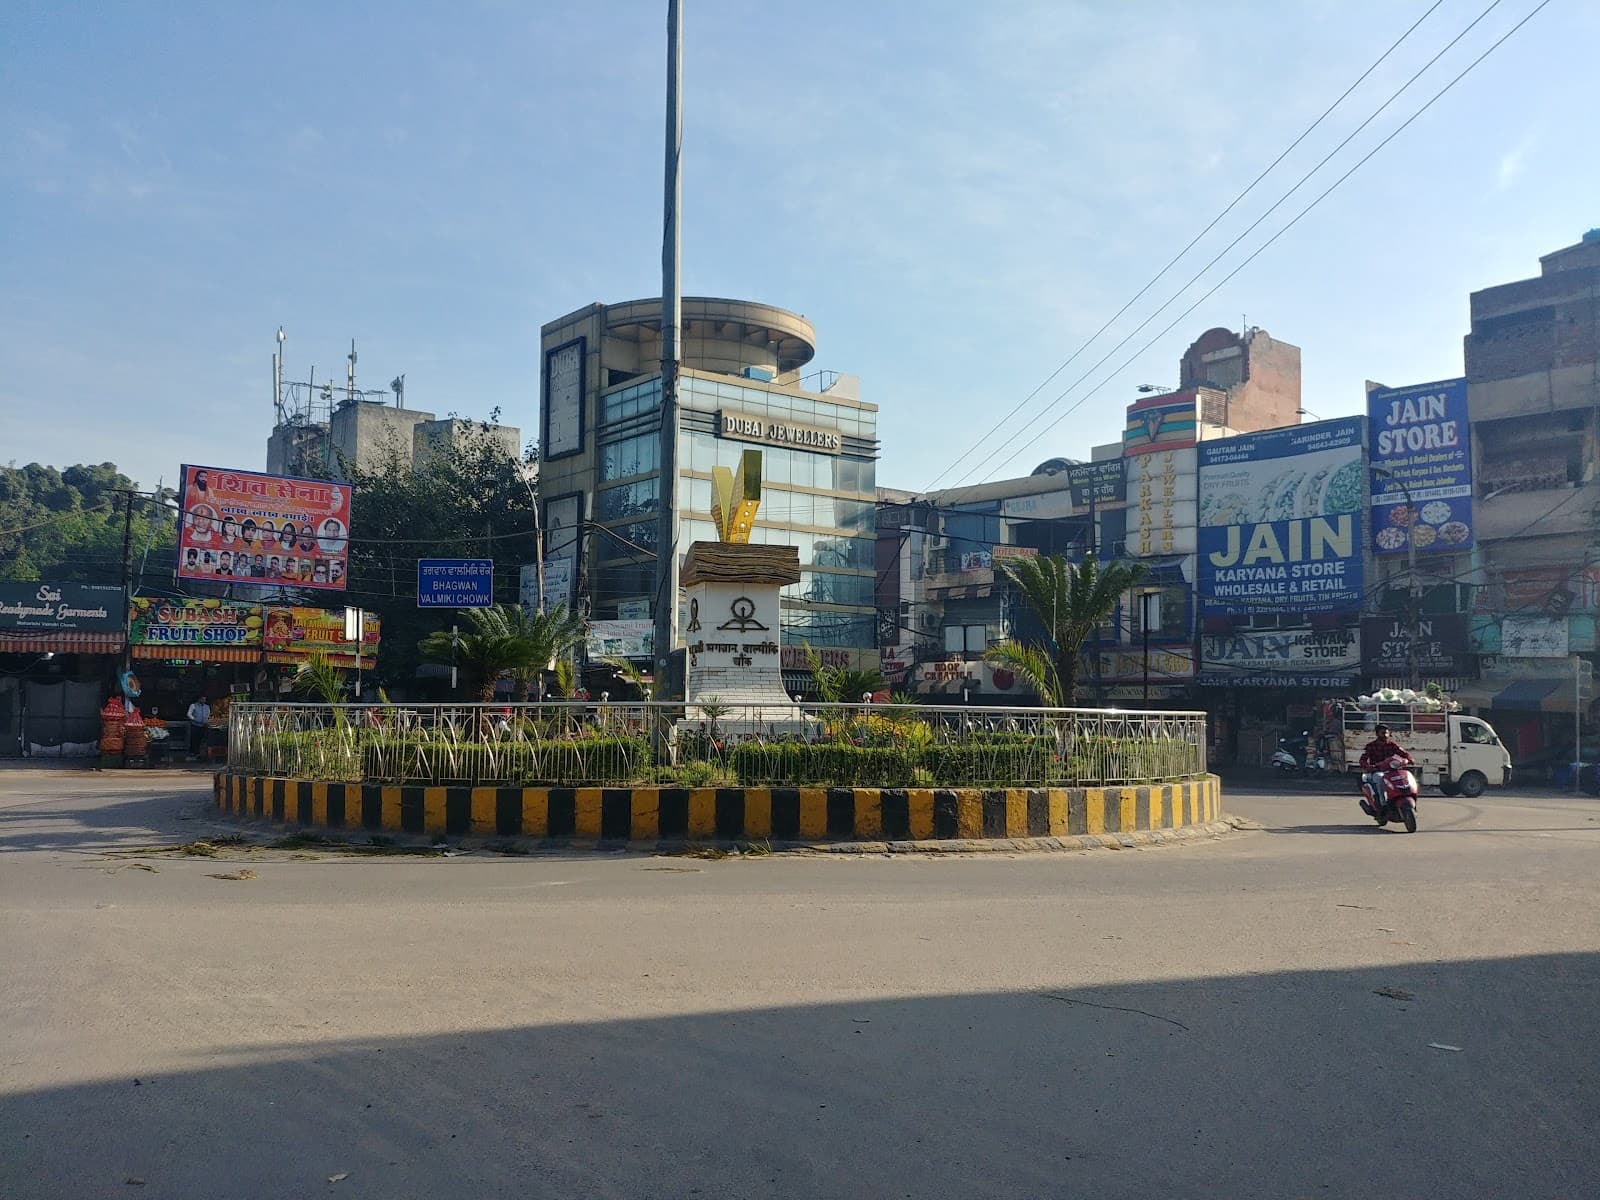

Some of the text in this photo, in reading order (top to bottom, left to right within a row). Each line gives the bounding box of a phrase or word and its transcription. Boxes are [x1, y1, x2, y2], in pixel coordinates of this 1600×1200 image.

[1386, 394, 1446, 426] JAIN
[726, 416, 839, 449] DUBAI JEWELLERS
[1335, 427, 1355, 438] JAIN
[1377, 421, 1459, 455] STORE
[1238, 443, 1255, 453] JAIN
[213, 473, 272, 497] शिव
[275, 480, 330, 504] सेना
[1139, 454, 1153, 554] PARKASH
[1209, 514, 1353, 567] JAIN
[422, 566, 447, 576] ਭਗਵਾਨ
[1215, 561, 1345, 582] KARYANA STORE
[36, 584, 62, 602] Sai
[432, 580, 478, 591] BHAGWAN
[1214, 578, 1346, 596] WHOLESALE & RETAIL
[420, 593, 490, 604] VALMIKI CHOWK
[1274, 594, 1289, 604] DRY
[56, 603, 108, 620] Garments
[157, 606, 238, 624] SUBASH
[294, 618, 306, 628] JAI
[1388, 621, 1432, 637] JAN
[147, 626, 247, 642] FRUIT SHOP
[306, 629, 334, 642] FRUIT
[1205, 632, 1356, 660] JAIN KARYANA
[1303, 645, 1348, 658] STORE
[1232, 677, 1298, 687] KARYANA
[1302, 677, 1351, 687] STORE
